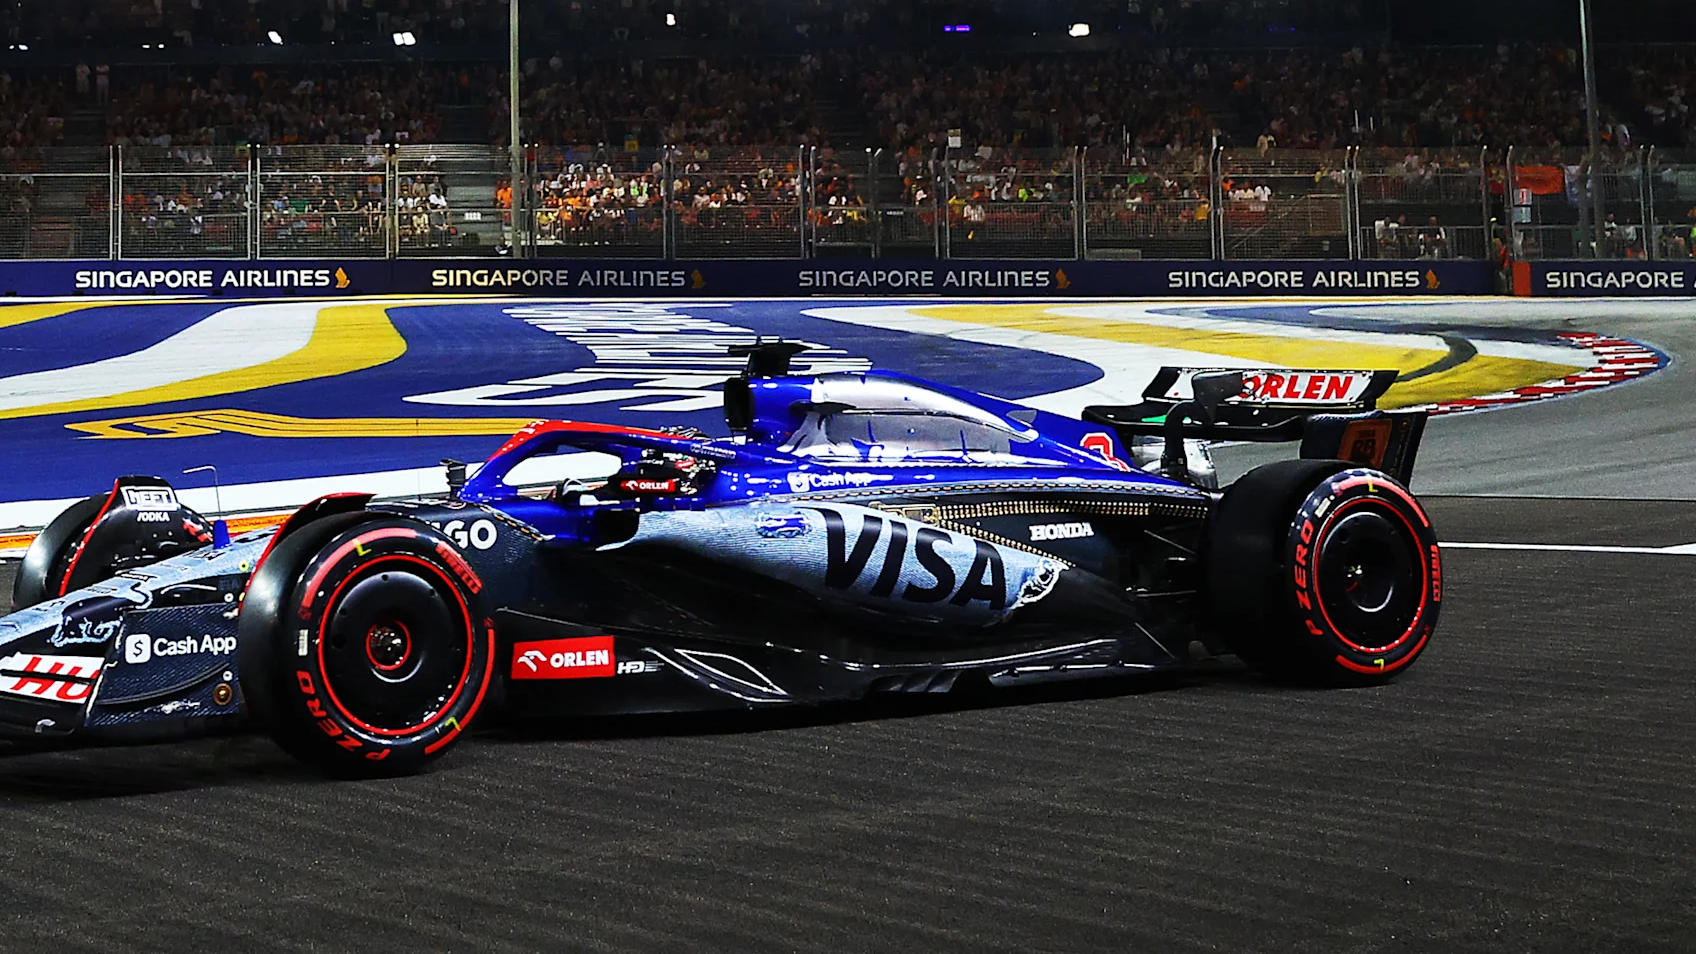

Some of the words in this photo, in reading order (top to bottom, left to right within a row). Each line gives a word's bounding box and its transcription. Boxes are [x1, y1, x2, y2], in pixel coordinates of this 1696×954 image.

[75, 269, 213, 288] SINGAPORE
[220, 268, 330, 288] AIRLINES
[431, 269, 569, 287] SINGAPORE
[577, 269, 686, 287] AIRLINES
[798, 270, 934, 288] SINGAPORE
[942, 270, 1050, 288] AIRLINES
[1168, 271, 1304, 288] SINGAPORE
[1312, 271, 1420, 288] AIRLINES
[1546, 271, 1685, 288] SINGAPORE
[1240, 375, 1354, 400] ORLEN
[639, 480, 670, 491] ORLEN
[809, 472, 844, 488] Cash
[845, 471, 873, 487] App
[431, 519, 498, 551] GO
[1029, 521, 1095, 541] HONDA
[794, 506, 1008, 611] VISA
[1294, 519, 1314, 611] ZERO
[154, 635, 198, 657] Cash
[200, 634, 238, 656] App
[550, 649, 610, 668] ORLEN
[296, 670, 364, 752] ZERO
[365, 748, 391, 761] P
